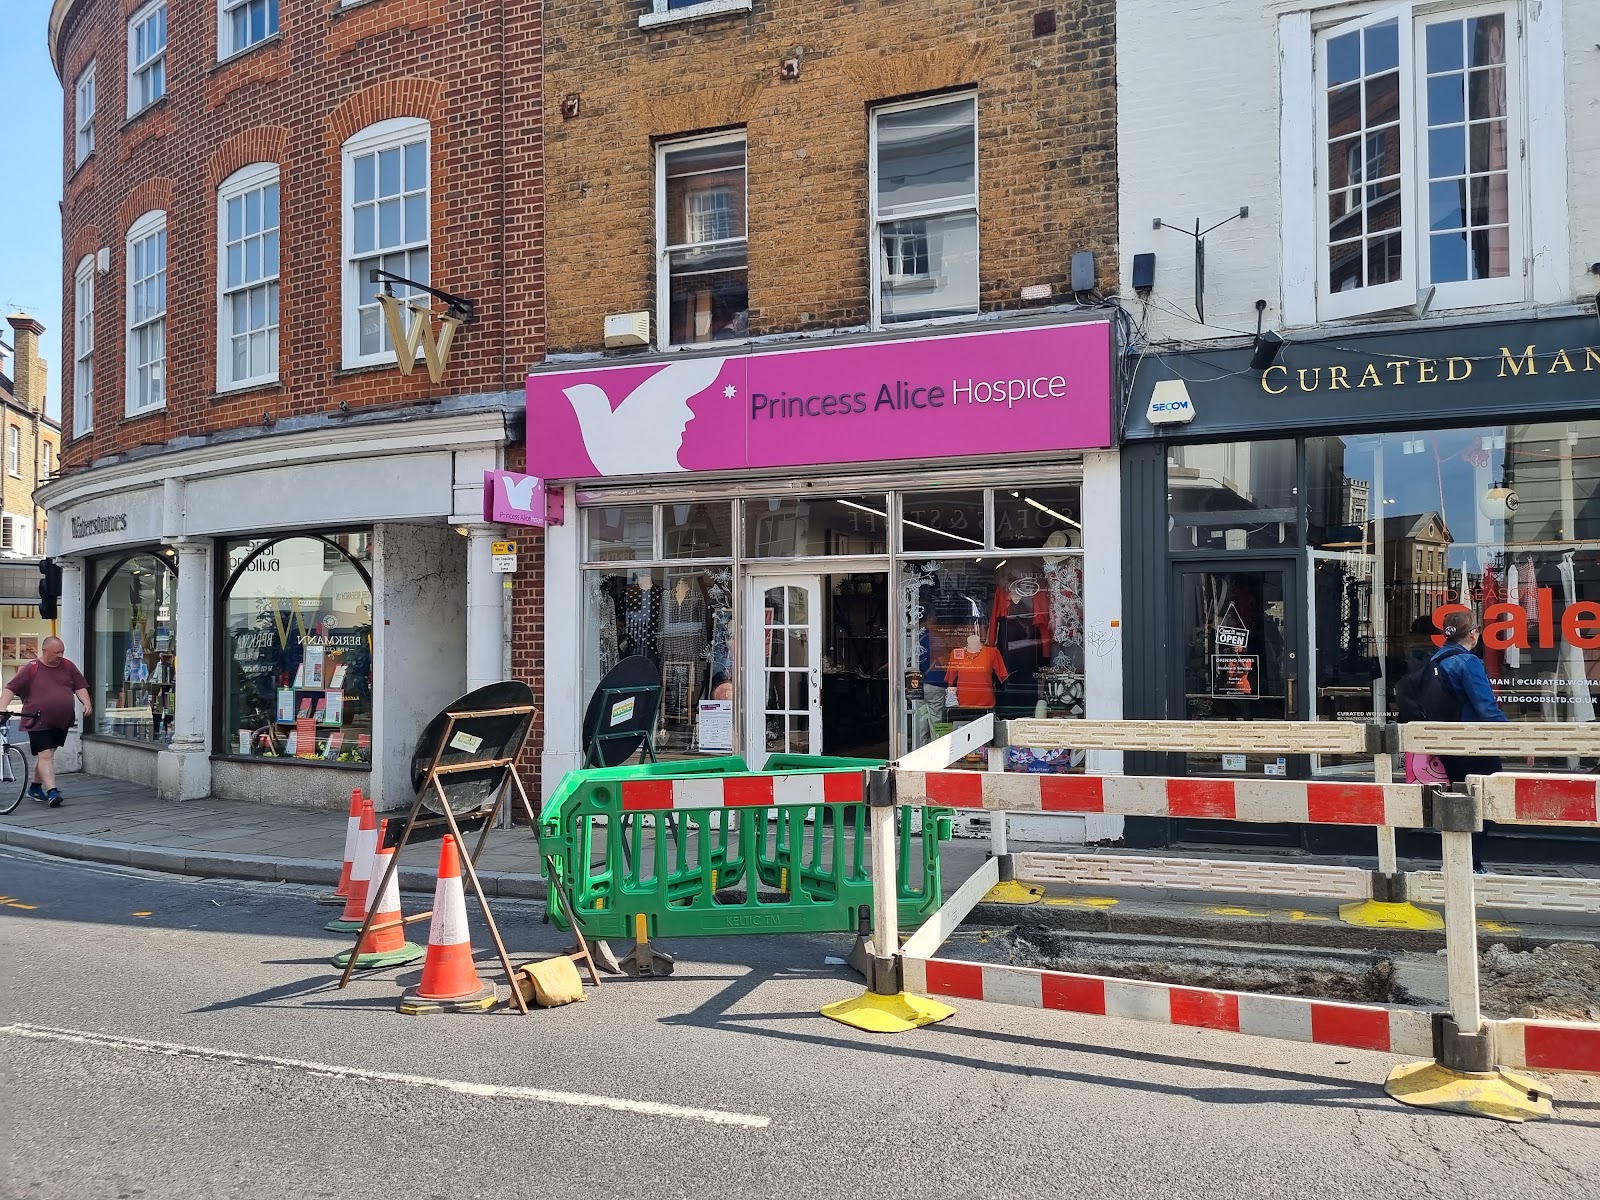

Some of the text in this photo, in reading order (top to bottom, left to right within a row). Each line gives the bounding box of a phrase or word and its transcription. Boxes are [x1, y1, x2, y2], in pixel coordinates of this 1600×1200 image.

[374, 293, 464, 384] W
[751, 374, 1067, 420] Princess Alice Hospice
[1152, 401, 1188, 412] SECOM
[499, 511, 520, 521] Princess
[71, 513, 127, 539] Waterstones
[1219, 634, 1245, 646] OPEN
[1517, 678, 1600, 687] @CURATED.WOMA
[1494, 695, 1598, 704] ATEDGOODSLTD.CO.UK
[726, 914, 781, 927] KELTIC TM
